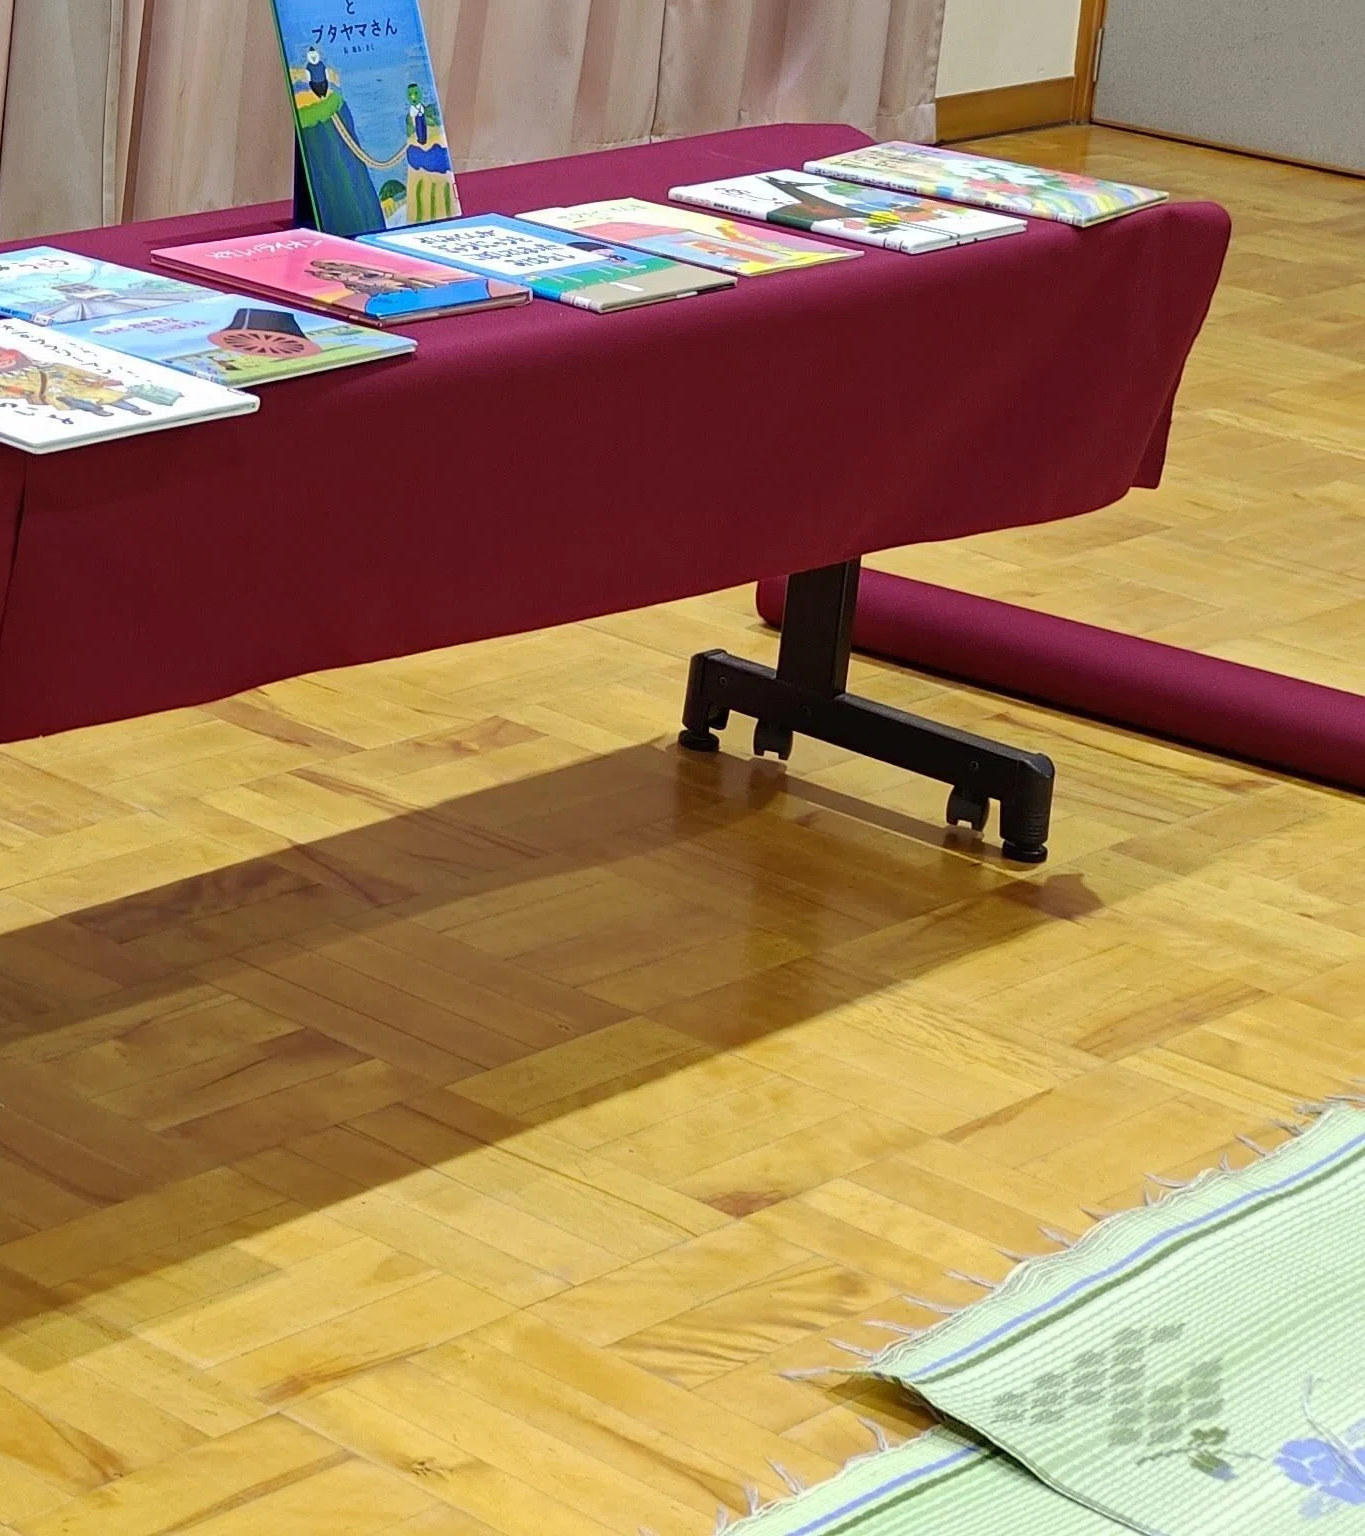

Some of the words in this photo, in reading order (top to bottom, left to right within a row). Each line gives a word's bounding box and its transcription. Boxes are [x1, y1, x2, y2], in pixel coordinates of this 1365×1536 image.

[345, 0, 356, 15] と
[311, 17, 398, 44] ブタヤマさん
